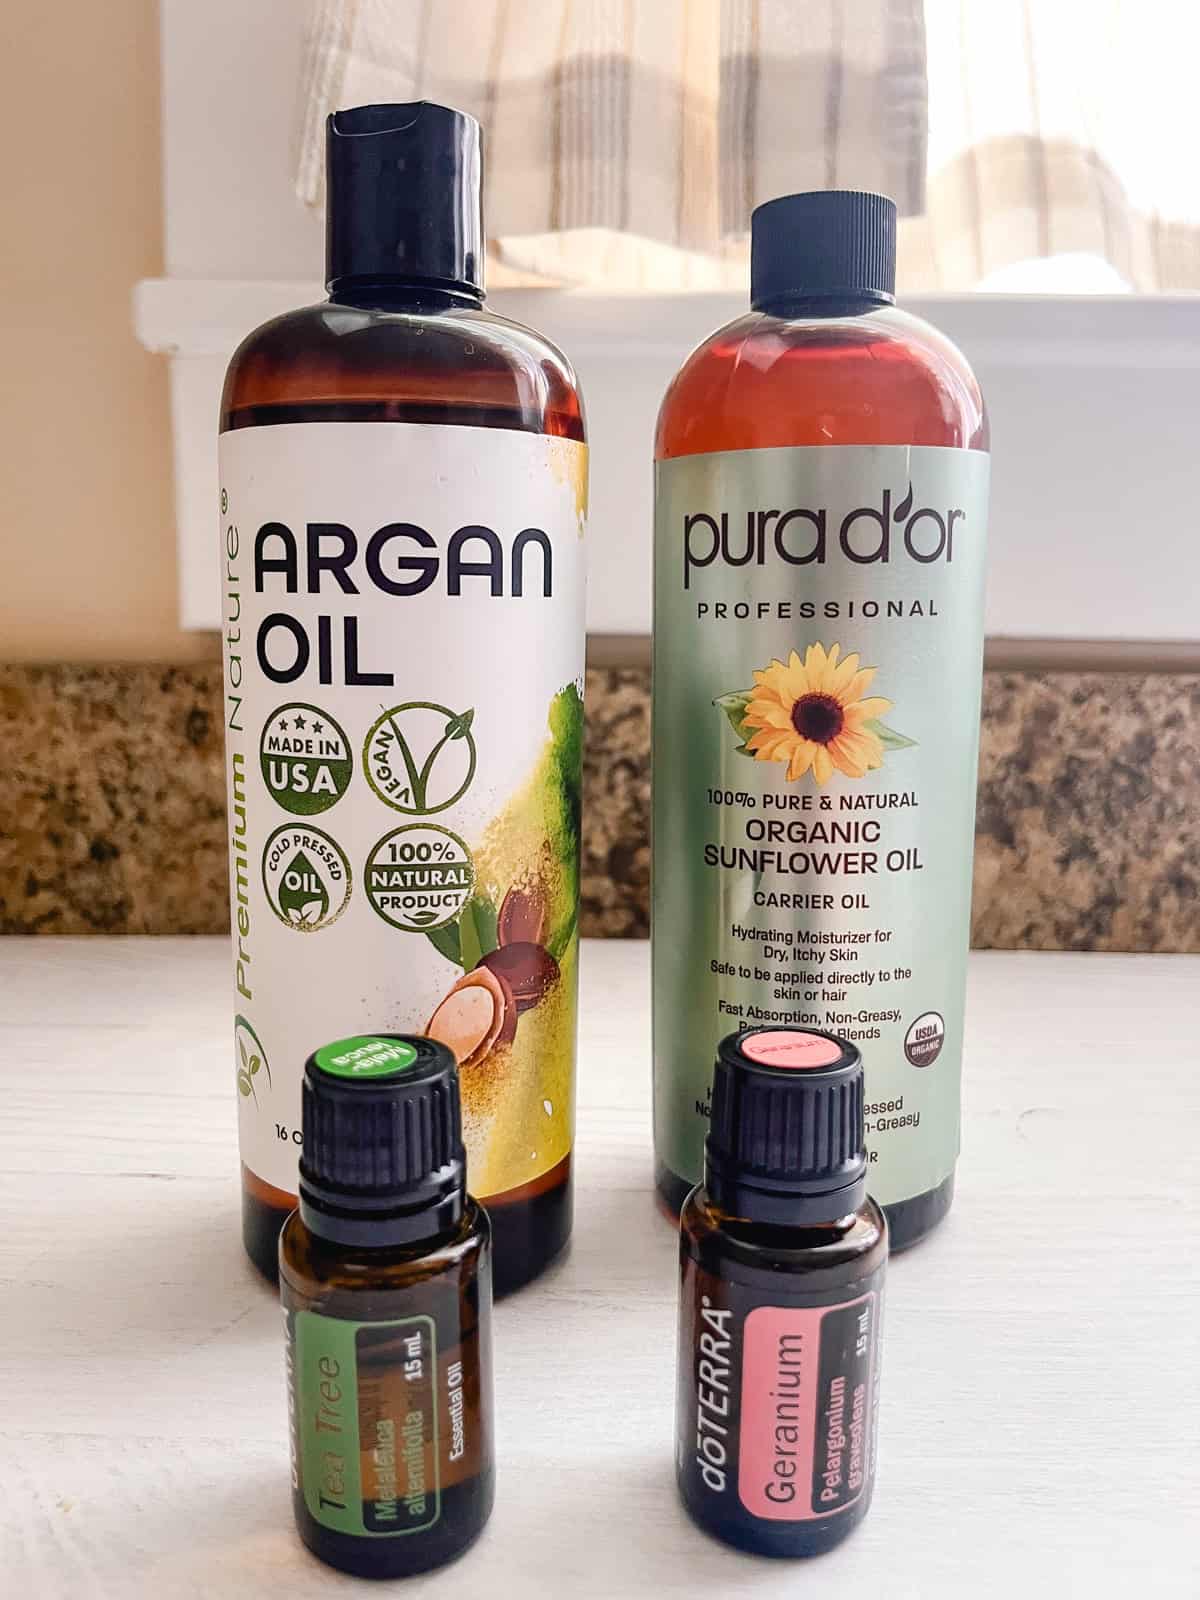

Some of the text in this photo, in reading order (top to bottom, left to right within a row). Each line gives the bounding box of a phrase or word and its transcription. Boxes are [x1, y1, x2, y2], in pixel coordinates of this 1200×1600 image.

[254, 522, 552, 597] ARGAN
[684, 508, 826, 589] pura
[697, 599, 938, 619] PROFESSIONAL
[256, 612, 394, 686] OIL
[268, 736, 339, 755] MADE IN
[269, 760, 338, 794] USA
[373, 730, 410, 804] VEGAN
[707, 789, 918, 810] 100% PURE & NATURAL
[745, 819, 881, 844] ORGANIC
[269, 835, 342, 880] COLD PRESSED
[388, 842, 455, 863] 100%
[704, 844, 923, 875] SUNFLOWER OIL
[233, 753, 252, 1000] Premium
[284, 871, 321, 894] OIL
[371, 868, 469, 887] NATURAL
[380, 894, 461, 909] PRODUCT
[754, 891, 870, 909] CARRIER OIL
[731, 923, 892, 945] Hydrating Moisturizer for
[764, 945, 858, 964] Dry, Itchy Skin
[711, 960, 912, 986] Safe to be applied directly to the
[774, 986, 848, 1001] skin or hair
[718, 1000, 902, 1025] Fast Absorption, Non-Greasy,
[838, 1027, 881, 1040] Blends
[915, 1023, 938, 1040] USDA
[911, 1039, 940, 1056] ORGANIC
[863, 1095, 903, 1115] essed
[275, 1123, 304, 1144] 16 O
[863, 1112, 920, 1133] n-Greasy
[403, 1331, 424, 1382] 15 mL
[856, 1334, 868, 1357] 15
[447, 1361, 464, 1461] Essential Oil
[764, 1333, 803, 1503] Geranium
[315, 1355, 347, 1511] Tea Tree
[821, 1376, 846, 1502] Pelargonium
